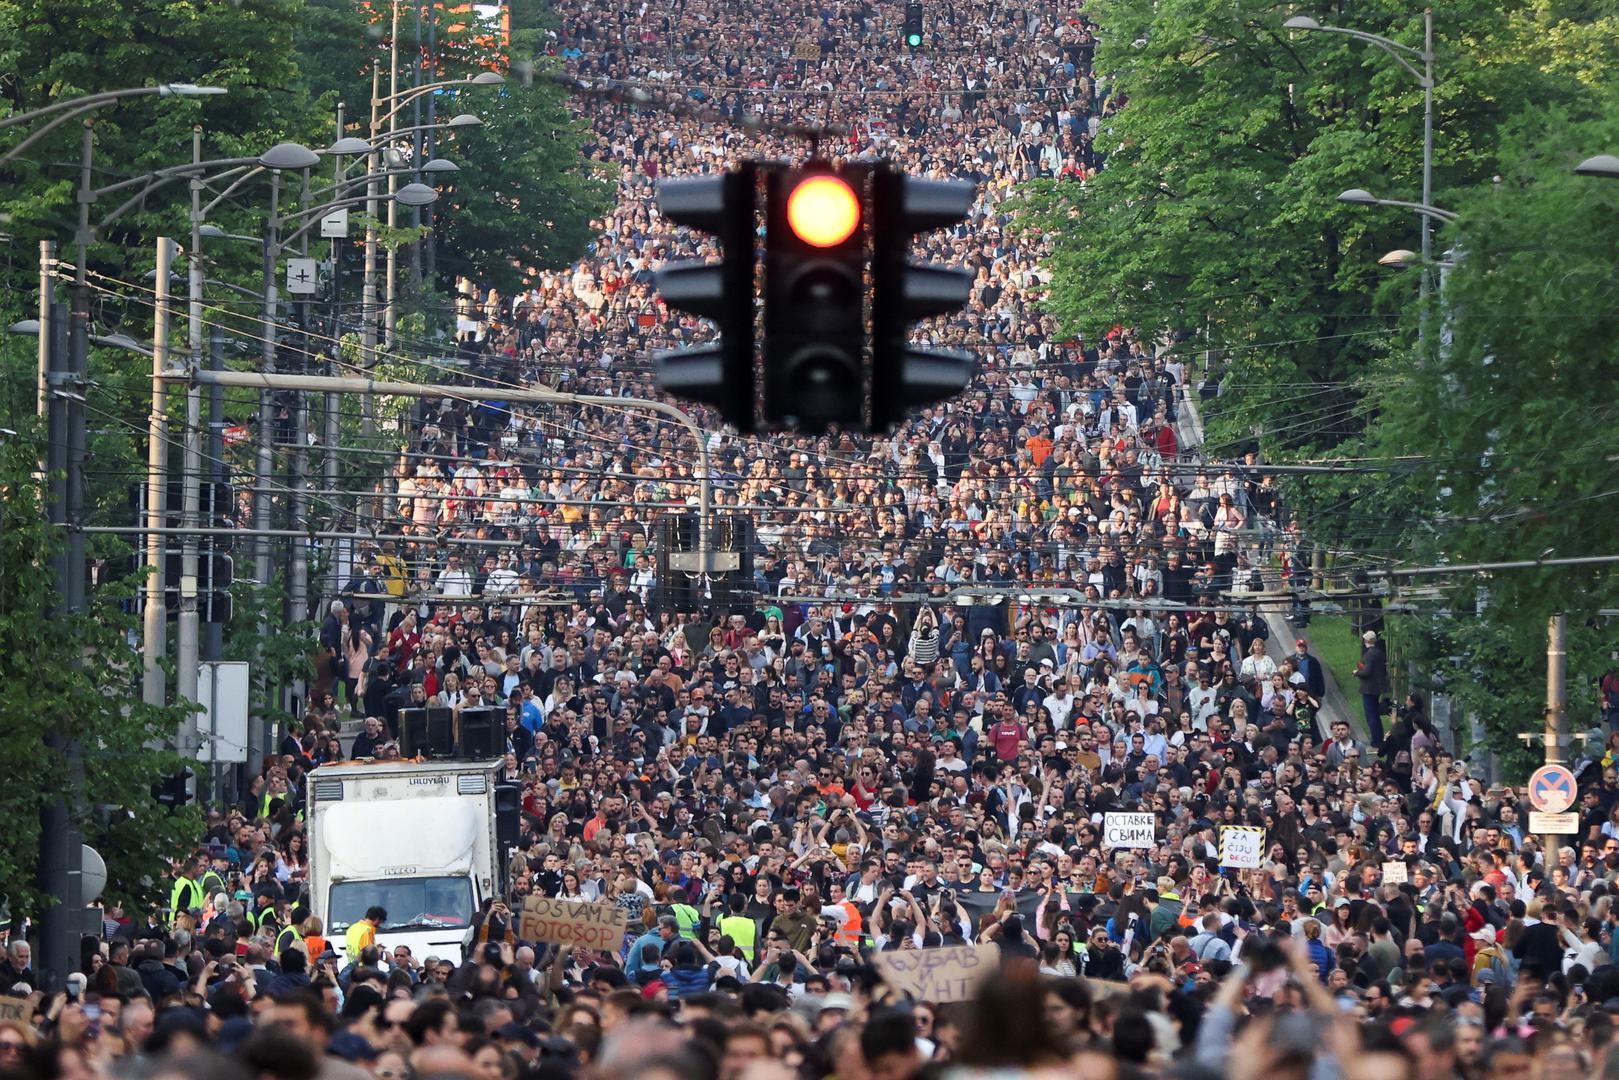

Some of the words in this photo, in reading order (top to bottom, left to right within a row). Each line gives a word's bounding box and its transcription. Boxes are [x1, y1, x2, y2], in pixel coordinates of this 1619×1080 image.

[1106, 814, 1154, 827] ОСТАВКЕ
[1108, 828, 1153, 843] СВИМА
[1232, 832, 1248, 842] ZA
[567, 902, 602, 923] VAM
[602, 908, 624, 927] JE
